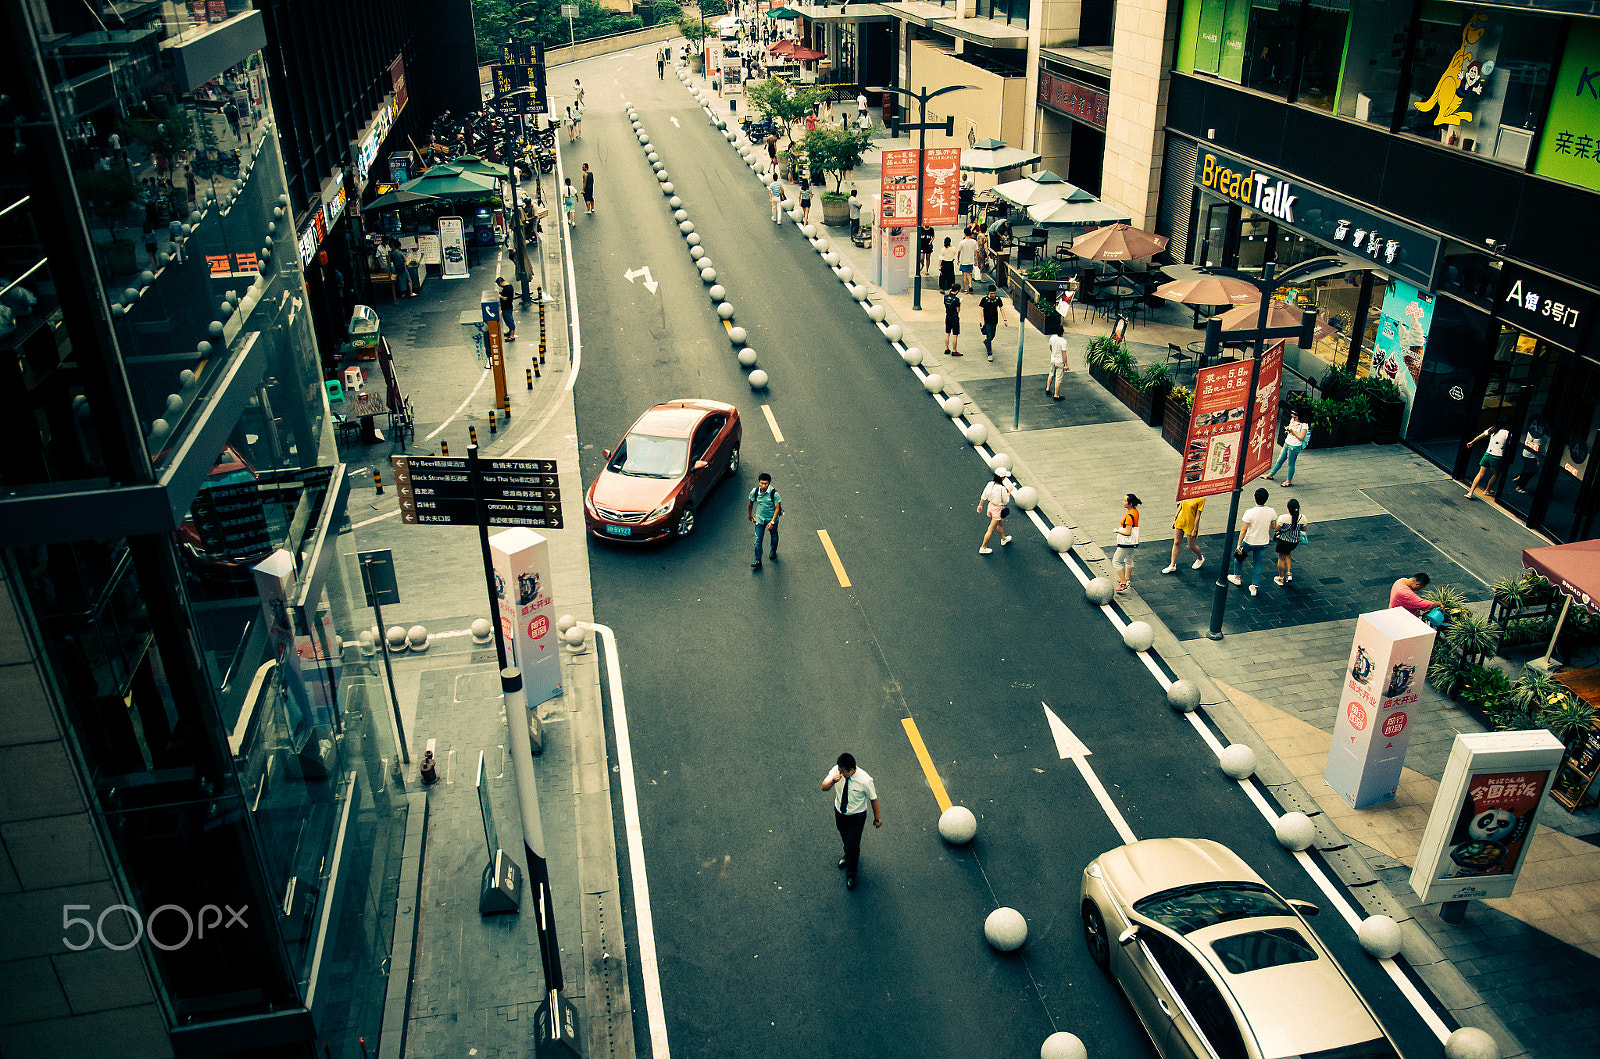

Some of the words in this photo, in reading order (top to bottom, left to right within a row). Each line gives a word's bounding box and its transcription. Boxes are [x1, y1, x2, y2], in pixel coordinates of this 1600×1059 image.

[1576, 66, 1600, 100] K
[1202, 154, 1297, 222] BreadTalk
[1506, 280, 1540, 312] A馆
[1541, 299, 1580, 328] 3号门
[409, 460, 419, 468] My
[1348, 679, 1377, 707] 盛大开业
[1384, 694, 1418, 709] 盛大开业
[1470, 782, 1537, 801] 全国开饭
